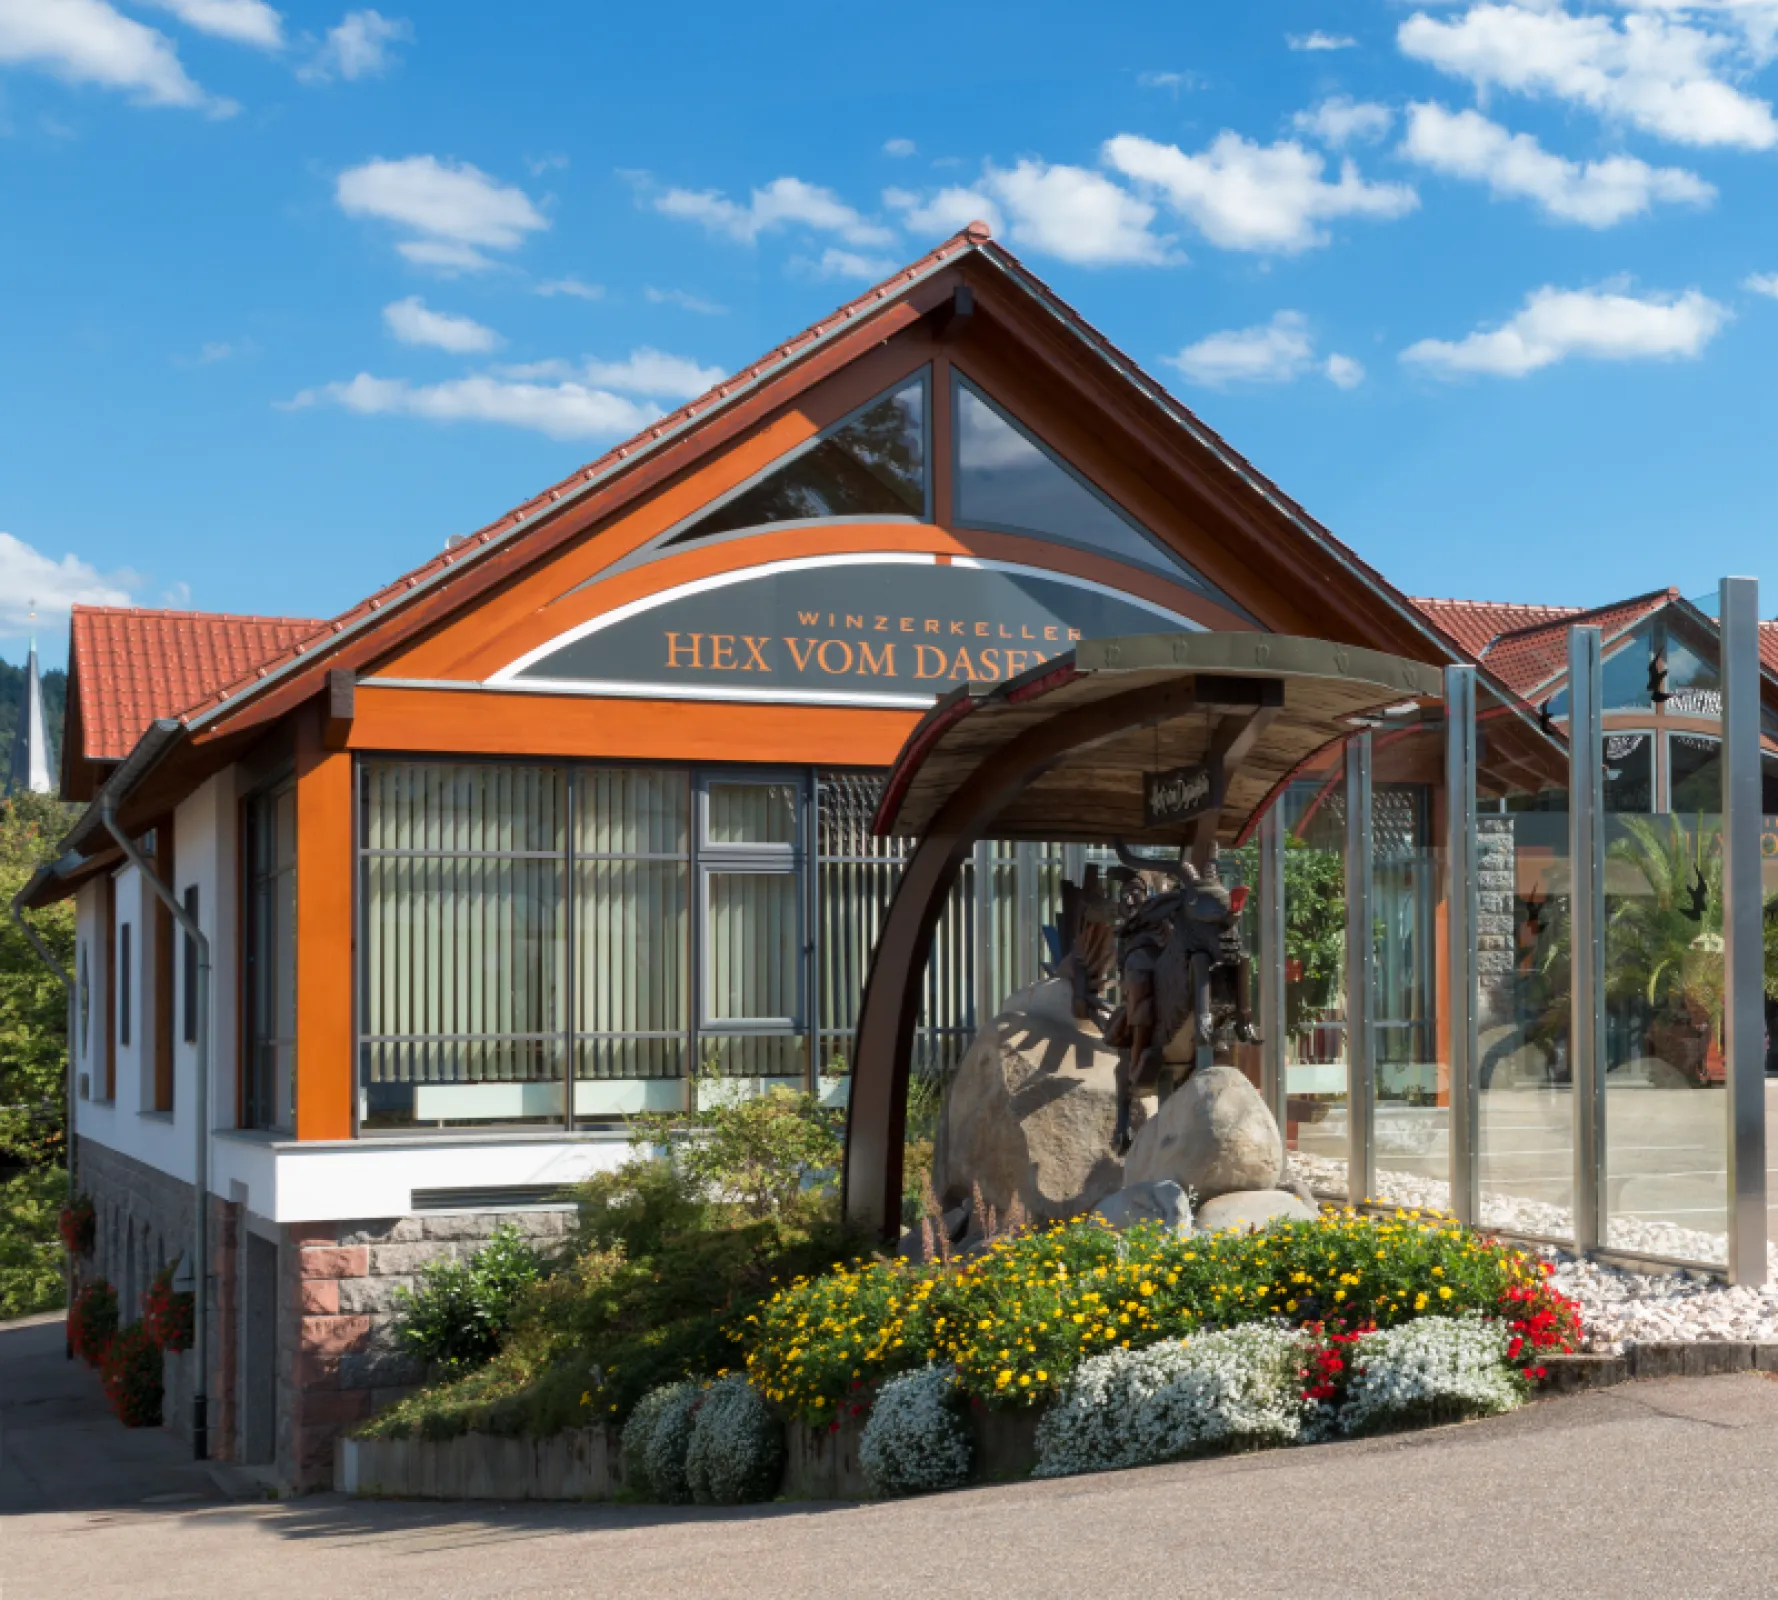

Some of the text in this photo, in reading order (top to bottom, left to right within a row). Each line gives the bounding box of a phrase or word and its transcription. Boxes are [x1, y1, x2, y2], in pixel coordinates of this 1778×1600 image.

[798, 611, 1081, 641] WINZERKELLER
[664, 631, 772, 672] HEX
[783, 636, 897, 678] VOM
